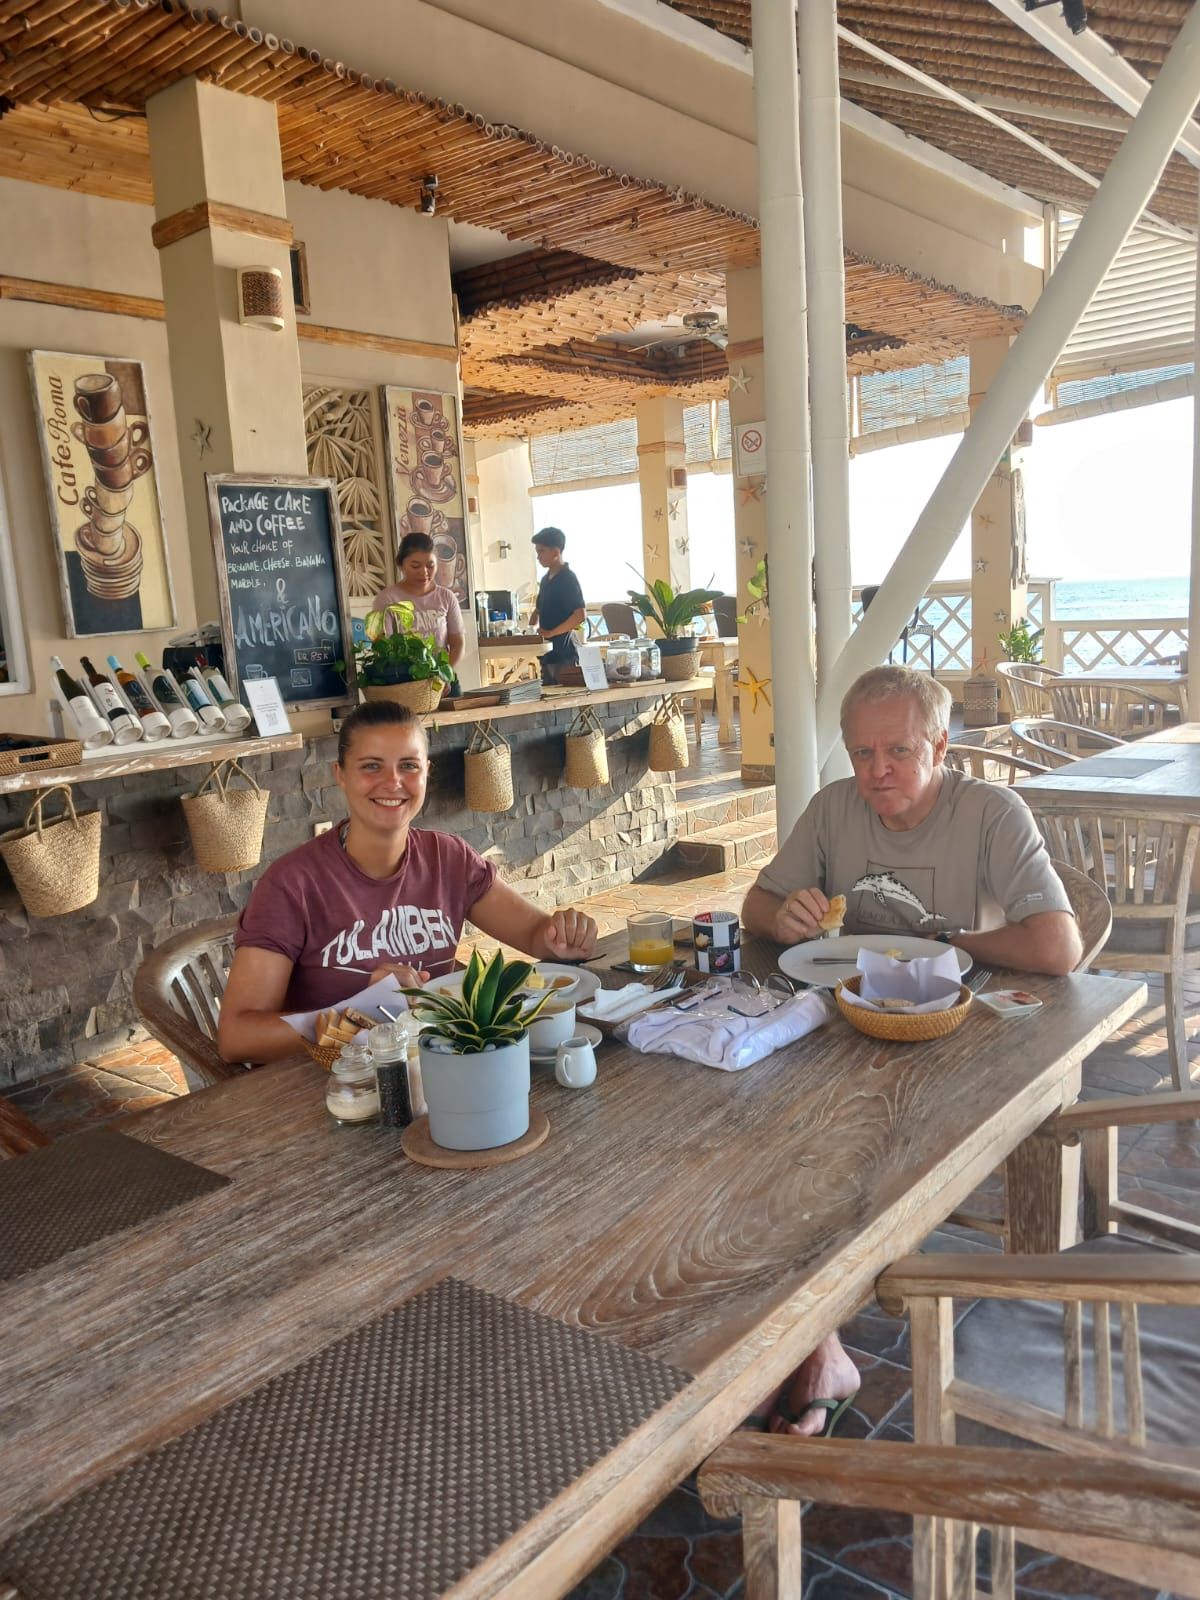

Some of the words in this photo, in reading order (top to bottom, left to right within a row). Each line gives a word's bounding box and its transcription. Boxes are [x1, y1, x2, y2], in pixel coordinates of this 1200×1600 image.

[47, 375, 71, 444] Roma
[393, 407, 412, 475] Venezia
[52, 444, 79, 506] Cafe
[274, 490, 311, 515] CAKE
[229, 519, 253, 534] AND
[256, 514, 305, 536] COFFEE
[231, 540, 250, 555] YOUR
[252, 539, 278, 553] CHOICE
[282, 540, 294, 555] OF
[295, 554, 326, 568] BANANA
[276, 578, 288, 604] &
[235, 595, 337, 649] AMERICANO
[320, 905, 458, 967] TULAMBEN
